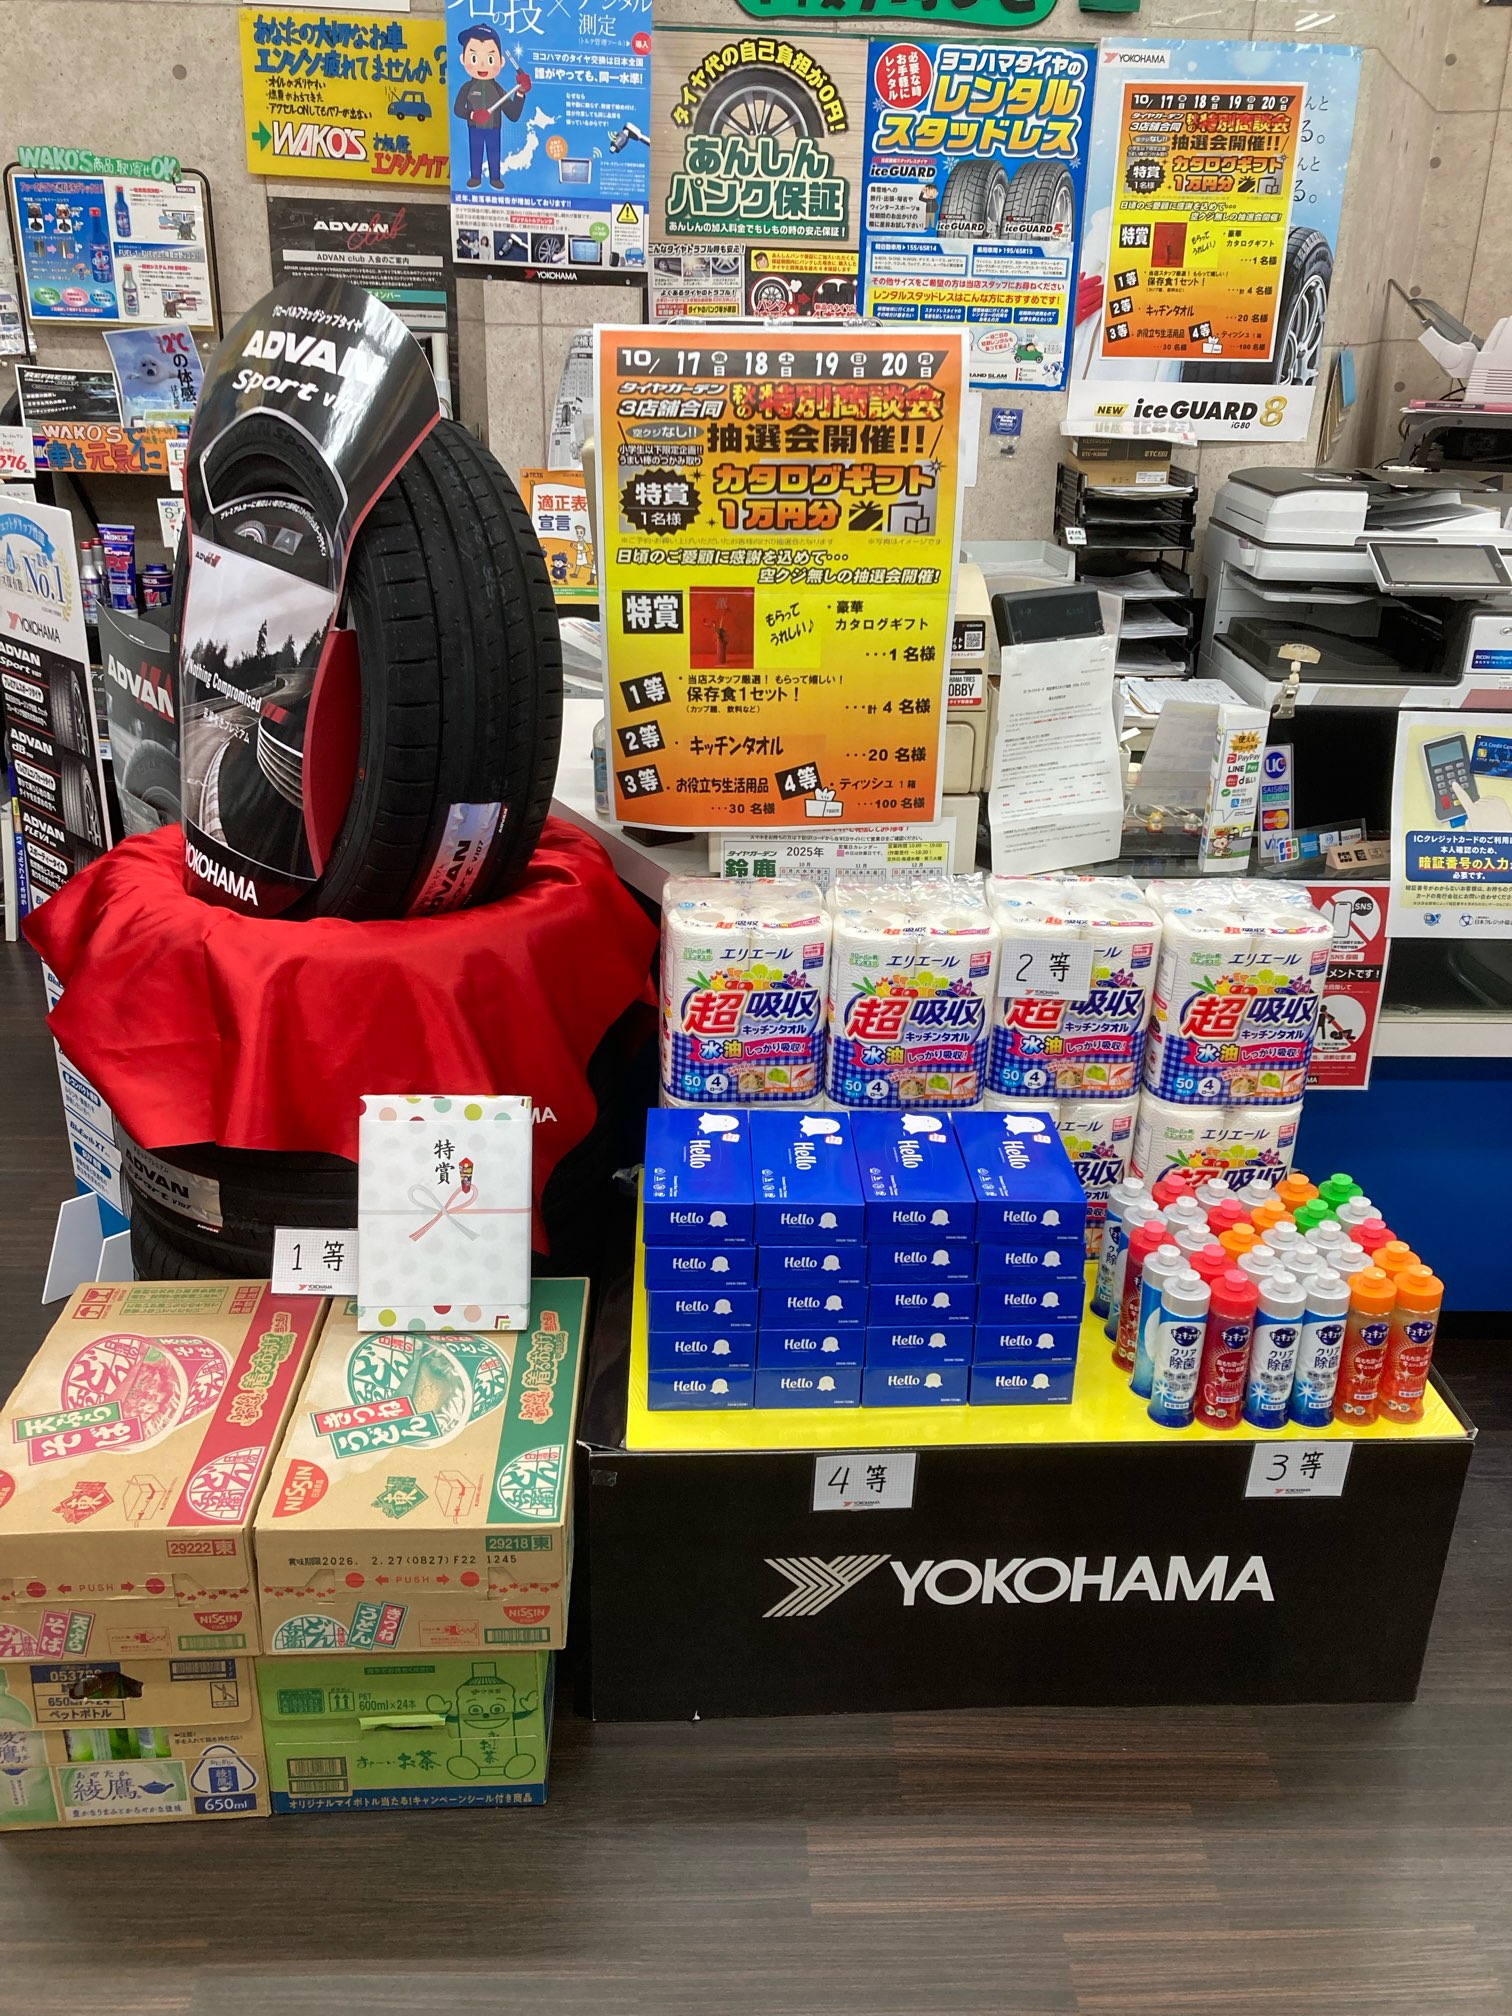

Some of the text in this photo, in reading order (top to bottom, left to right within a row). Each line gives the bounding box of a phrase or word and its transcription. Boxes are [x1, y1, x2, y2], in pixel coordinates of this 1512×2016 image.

[253, 14, 407, 52] あなたの大切なお車
[579, 14, 616, 37] 測定
[636, 41, 649, 49] 導入
[532, 52, 643, 67] ヨコハマのタイヤ交換は日本全国
[940, 51, 1081, 76] ヨコハマタイヤの
[1119, 53, 1166, 64] YOKOHAMA
[885, 56, 898, 100] レンタル
[896, 53, 910, 99] お手軽に
[908, 52, 922, 97] 必要な時
[933, 75, 1079, 117] レンタル
[1161, 95, 1275, 110] 17 18 19 20
[272, 120, 369, 160] WAKO'S
[879, 116, 1076, 151] スタッドレス
[686, 135, 833, 179] あんしん
[1172, 156, 1283, 173] カタログギフト
[870, 164, 936, 178] iceGUARD
[1133, 166, 1160, 179] 特賞
[1173, 175, 1235, 192] 1万円分
[666, 172, 847, 221] パンク保証
[313, 220, 389, 233] ADVAN
[1121, 227, 1150, 246] 特賞
[1226, 239, 1275, 248] カタログギフト
[317, 253, 345, 262] ADVAN
[348, 254, 364, 262] club
[537, 271, 577, 281] YOKOHAMA
[1117, 272, 1137, 289] 1等
[871, 277, 1065, 292] その他サイズをご希望の方は当店スタッフにお尋ねください
[1112, 299, 1132, 315] 2等
[1145, 305, 1194, 317] キッチンタオル
[1109, 325, 1128, 340] 3等
[1192, 325, 1210, 338] 4等
[242, 330, 386, 384] ADVAN
[677, 351, 908, 377] 17 18 19 20
[232, 369, 320, 402] Sport
[618, 382, 726, 395] タイヤガーデン
[617, 399, 725, 418] 3店舗合同
[1097, 395, 1288, 427] NEW iceGUARD 8
[1231, 422, 1250, 430] iG80
[707, 423, 925, 454] 抽選会開催!!
[47, 440, 162, 472] 車を元気に
[618, 455, 702, 466] うまい棒のつかみ取り
[713, 463, 936, 495] カタログギフト
[635, 482, 689, 507] 特賞
[640, 512, 682, 527] 1名様
[717, 498, 842, 531] 1万円分
[538, 514, 571, 531] 宣言
[22, 556, 66, 604] No.1
[758, 568, 941, 584] 空クジ無しの抽選会開催!
[626, 595, 680, 630] 特賞
[765, 603, 800, 628] もらって
[19, 615, 61, 643] YOKOHAMA
[836, 618, 930, 631] カタログギフト
[903, 647, 936, 661] 名様
[107, 654, 175, 719] ADVAN
[188, 658, 262, 713] Nothing Compromised
[628, 676, 666, 706] 1等
[687, 686, 799, 702] 保存食1セット!
[883, 699, 931, 714] 4 名様
[11, 728, 54, 756] ADVAN
[624, 725, 660, 751] 2等
[690, 736, 784, 757] キッチンタオル
[894, 747, 927, 762] 名様
[1237, 754, 1260, 762] PayPay
[624, 769, 658, 793] 3等
[676, 777, 769, 794] お役立ち生活用品
[784, 768, 819, 793] 4等
[839, 777, 893, 791] ティッシュ
[750, 802, 776, 815] 名様
[901, 797, 925, 810] 名様
[23, 812, 65, 843] ADVAN
[25, 825, 50, 844] FLEVA
[786, 846, 824, 858] 2025年
[186, 840, 258, 906] YOKOHAMA
[725, 858, 777, 878] 鈴鹿
[1452, 871, 1487, 880] 必要です。
[1354, 902, 1372, 911] SNS
[720, 948, 793, 962] エリエール
[885, 954, 961, 968] エリエール
[1228, 953, 1302, 967] エリエール
[743, 1024, 806, 1035] キッチンタオル
[904, 1031, 970, 1043] キッチンタオル
[1241, 1030, 1304, 1040] キッチンタオル
[684, 1075, 701, 1087] 50
[712, 1076, 722, 1086] 4
[1002, 1070, 1019, 1081] 50
[1029, 1072, 1040, 1082] 4
[844, 1080, 862, 1092] 50
[872, 1082, 882, 1093] 4
[1175, 1078, 1194, 1089] 50
[1204, 1079, 1214, 1090] 4
[1200, 1128, 1271, 1141] エリエール
[434, 1138, 456, 1186] 特賞
[671, 1211, 704, 1227] Hello
[893, 1210, 927, 1225] Hello
[1004, 1210, 1037, 1226] Hello
[673, 1257, 706, 1272] Hello
[785, 1255, 818, 1270] Hello
[895, 1250, 928, 1265] Hello
[1006, 1251, 1039, 1267] Hello
[676, 1299, 709, 1314] Hello
[1171, 1348, 1197, 1358] クリア
[1269, 1350, 1294, 1359] クリア
[1316, 1347, 1341, 1356] クリア
[1169, 1356, 1196, 1370] 除菌
[1267, 1359, 1293, 1371] 除菌
[1314, 1356, 1339, 1369] 除菌
[40, 1421, 132, 1458] そば
[284, 1465, 314, 1512] NISSIN
[170, 1543, 212, 1555] 29222
[488, 1537, 529, 1550] 29218
[454, 1555, 477, 1565] F22
[486, 1554, 518, 1565] 1245
[395, 1575, 430, 1584] PUSH
[890, 1555, 1276, 1607] YOKOHAMA
[79, 1583, 114, 1592] PUSH
[199, 1614, 238, 1625] NISSIN
[508, 1608, 545, 1618] NISSIN
[351, 1607, 377, 1646] うどん
[41, 1617, 68, 1653] そば
[359, 1692, 372, 1700] PET
[359, 1699, 417, 1711] 600ml×24本
[50, 1708, 112, 1720] ペットボトル
[73, 1777, 138, 1801] 綾鷹
[204, 1798, 248, 1811] 650ml
